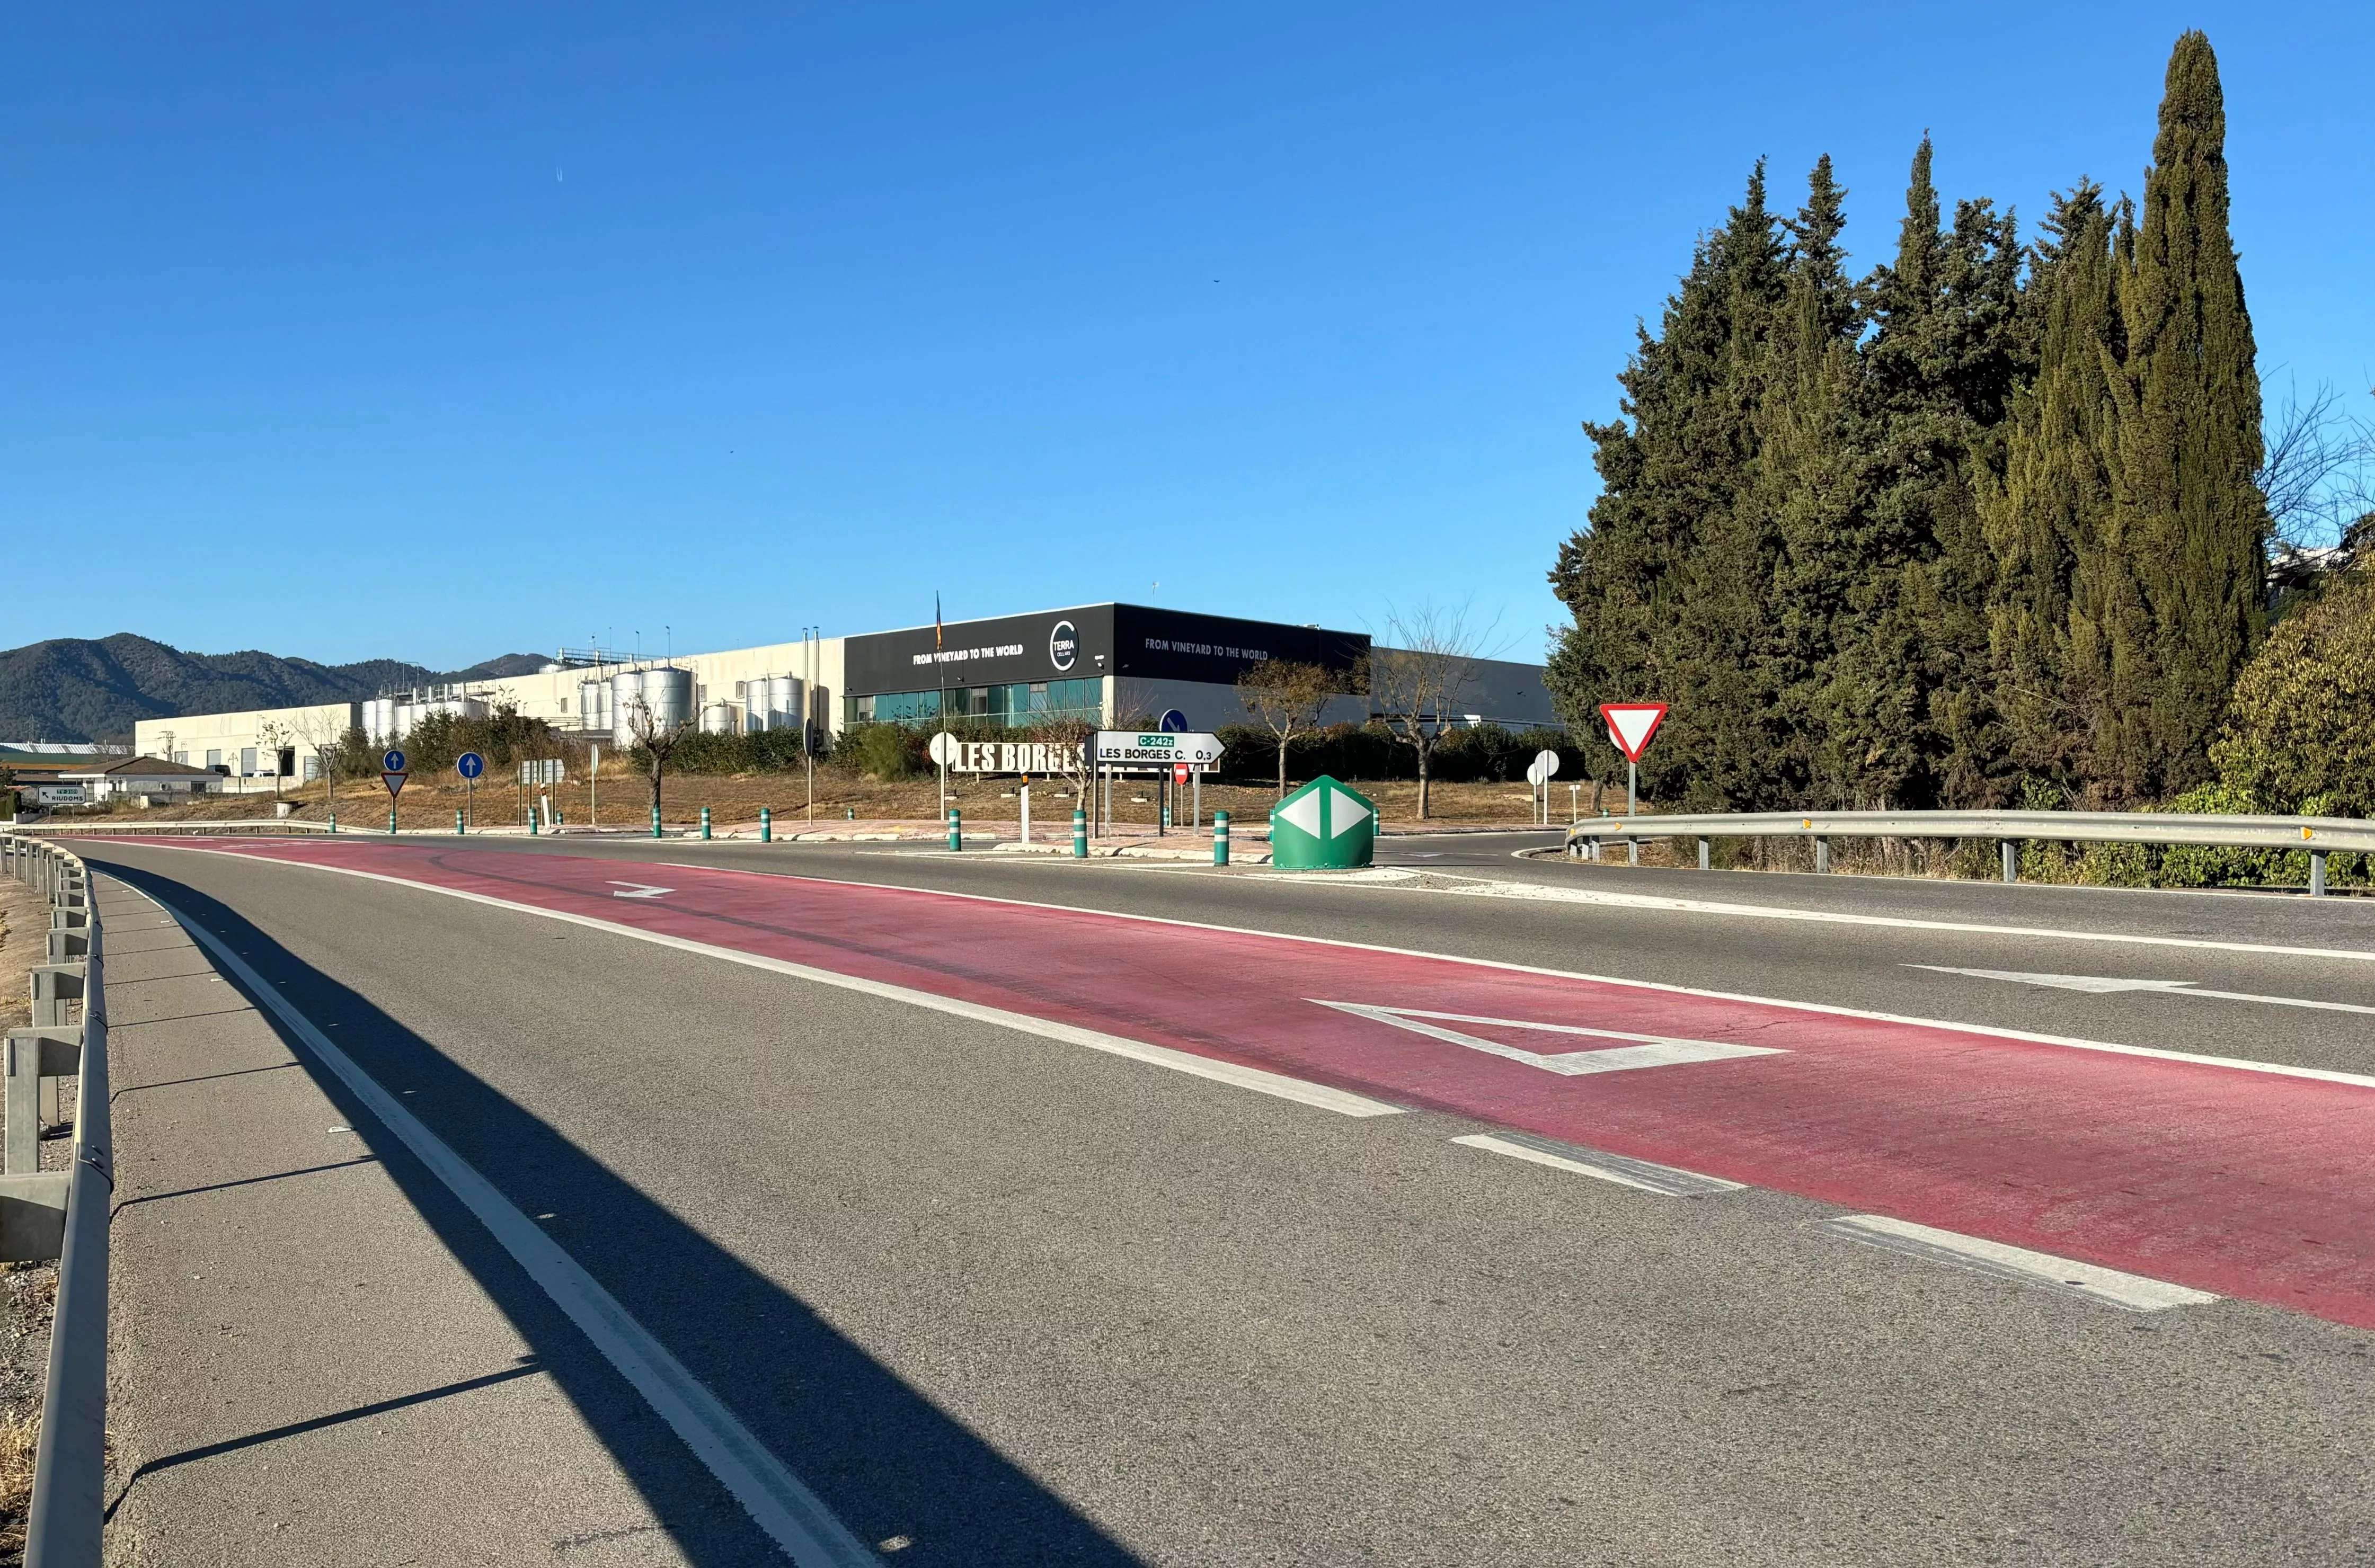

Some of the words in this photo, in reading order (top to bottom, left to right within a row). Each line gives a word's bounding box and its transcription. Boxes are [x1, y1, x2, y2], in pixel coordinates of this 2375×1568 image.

[1053, 639, 1074, 651] TERRA
[1146, 638, 1168, 651] FROM
[1172, 641, 1211, 655] VINEYARD
[1213, 646, 1224, 656] TO
[1226, 647, 1239, 657] THE
[1241, 649, 1268, 661] WORLD
[913, 654, 932, 665] FROM
[934, 650, 968, 663] VINEYARD
[970, 648, 980, 659] TO
[981, 647, 994, 658] THE
[996, 644, 1023, 656] WORLD
[1140, 737, 1173, 746] C-242z
[955, 744, 995, 771] LES
[1100, 749, 1121, 759] LES
[1125, 749, 1171, 760] BORGES
[1175, 750, 1186, 760] C.
[1195, 750, 1211, 761] 0,3
